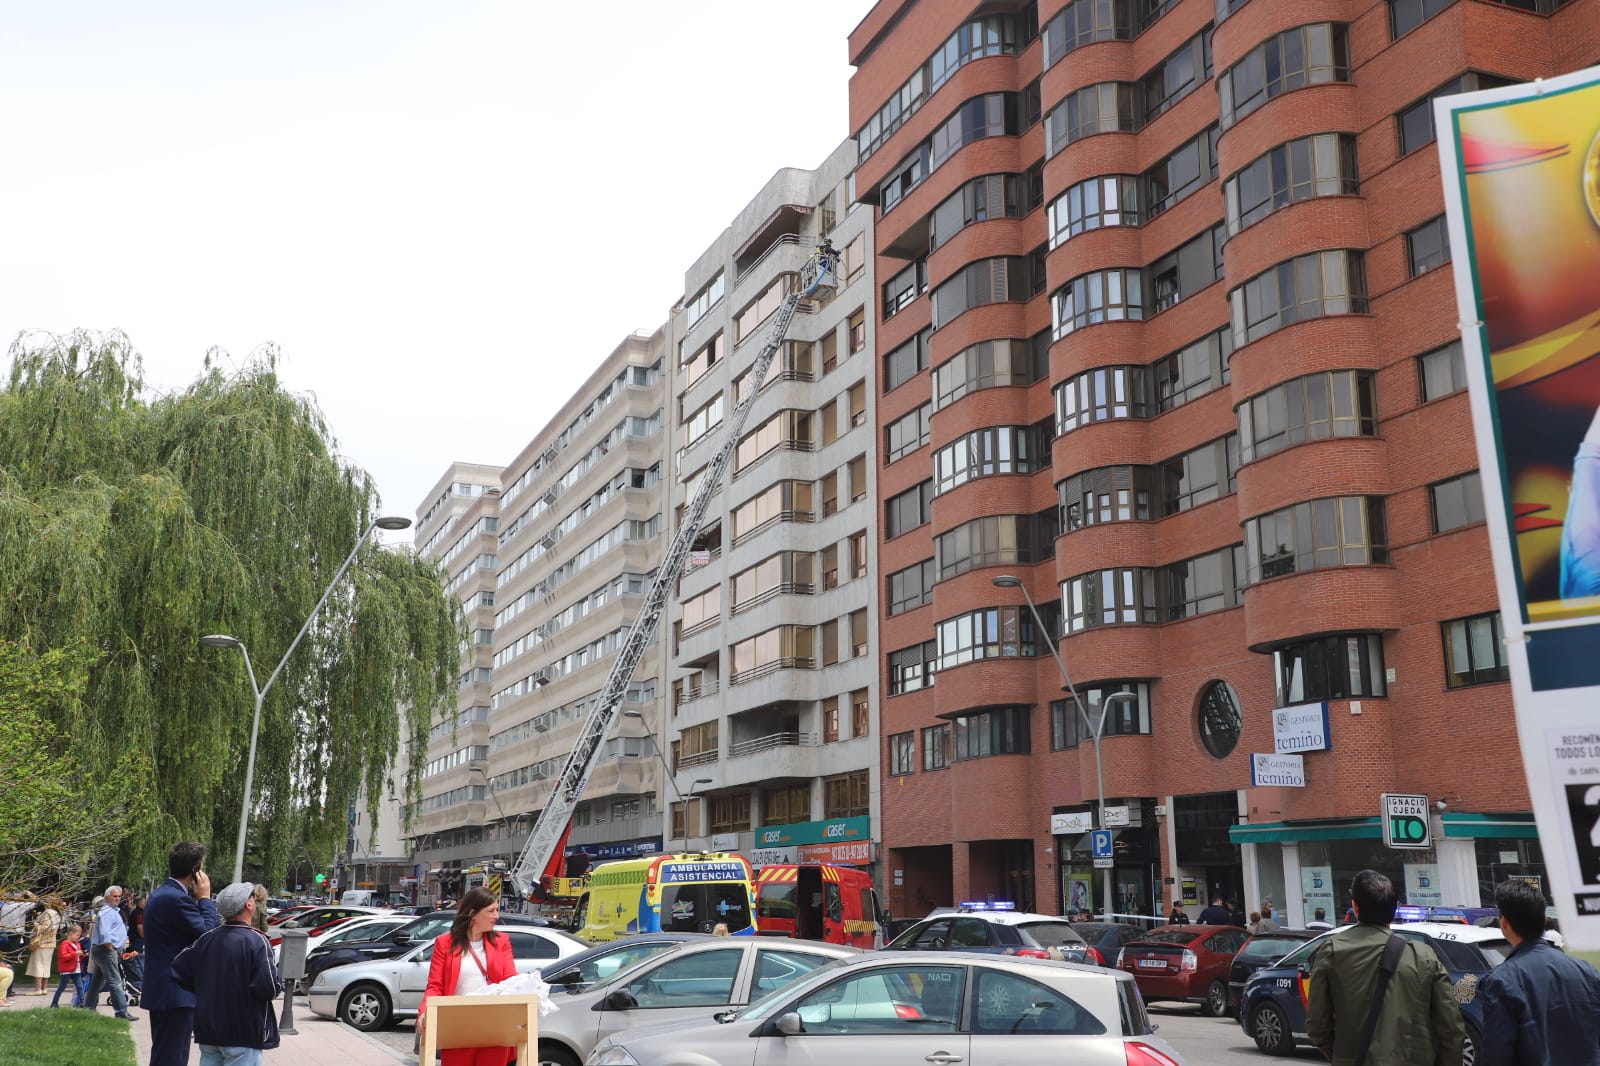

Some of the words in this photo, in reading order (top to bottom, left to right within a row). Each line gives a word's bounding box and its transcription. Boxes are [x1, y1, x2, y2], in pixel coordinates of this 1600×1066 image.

[1277, 730, 1322, 750] temiño
[1554, 746, 1587, 760] TODOS
[1258, 770, 1302, 785] temiño
[1388, 798, 1425, 807] IGNACIO
[1393, 806, 1422, 815] OJEDA
[765, 830, 781, 843] caser
[827, 823, 846, 837] caser
[1096, 834, 1108, 854] P
[670, 863, 738, 873] AMBULANCIA
[670, 872, 738, 881] ASISTENCIAL
